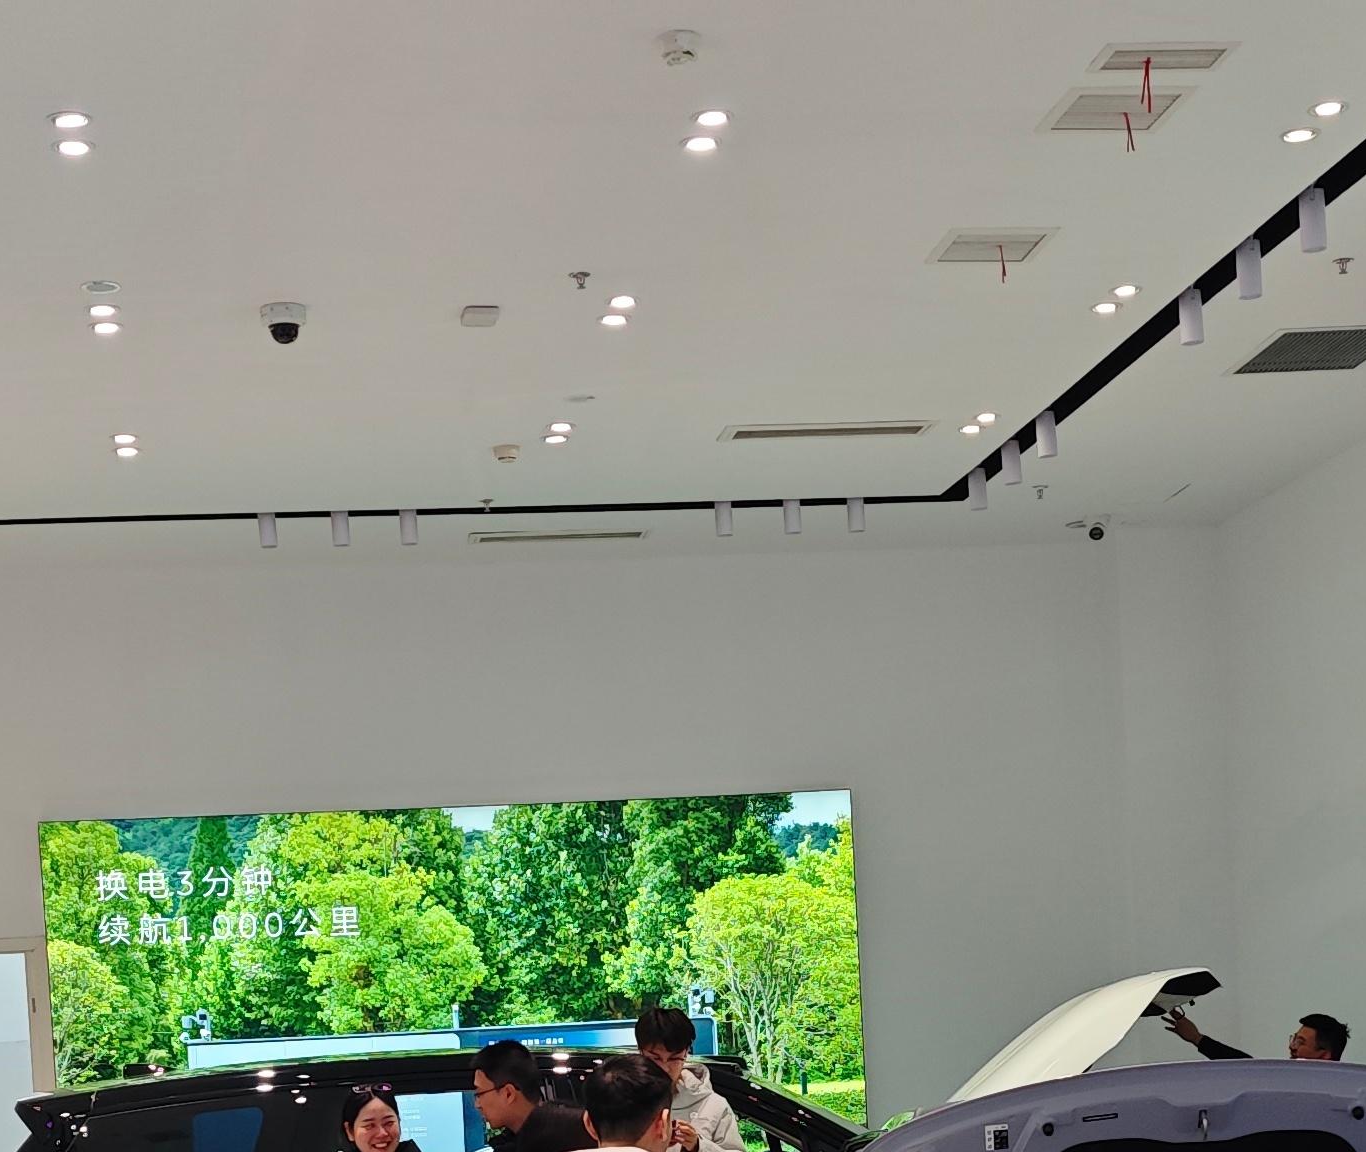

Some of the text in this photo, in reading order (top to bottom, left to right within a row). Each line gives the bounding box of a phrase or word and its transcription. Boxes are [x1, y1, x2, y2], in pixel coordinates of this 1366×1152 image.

[96, 865, 272, 901] 换电3分钟
[98, 905, 361, 945] 续航1,000公里
